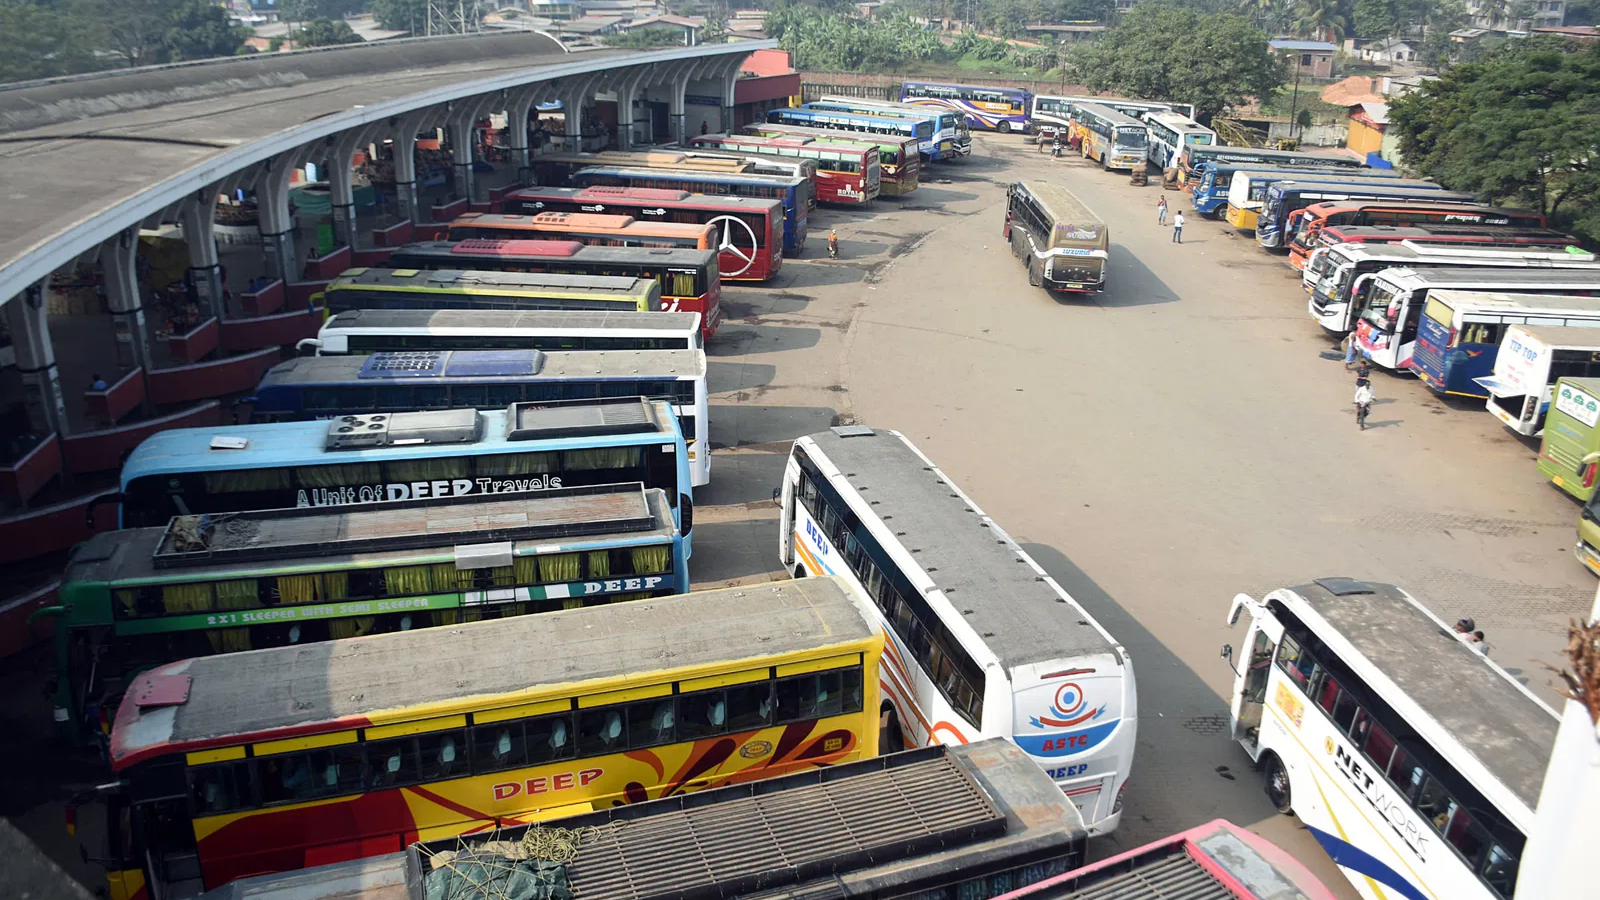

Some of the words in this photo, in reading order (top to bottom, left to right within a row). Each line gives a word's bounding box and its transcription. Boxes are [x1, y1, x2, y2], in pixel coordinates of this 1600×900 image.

[1522, 347, 1537, 361] TOP
[584, 577, 662, 594] DEEP
[242, 610, 296, 622] SLEEPER
[301, 606, 334, 617] WITH
[339, 603, 371, 613] SEMI
[377, 599, 430, 610] SLEEPER
[1042, 734, 1088, 752] ASTC
[1046, 763, 1088, 778] DEEP
[493, 768, 604, 801] DEEP
